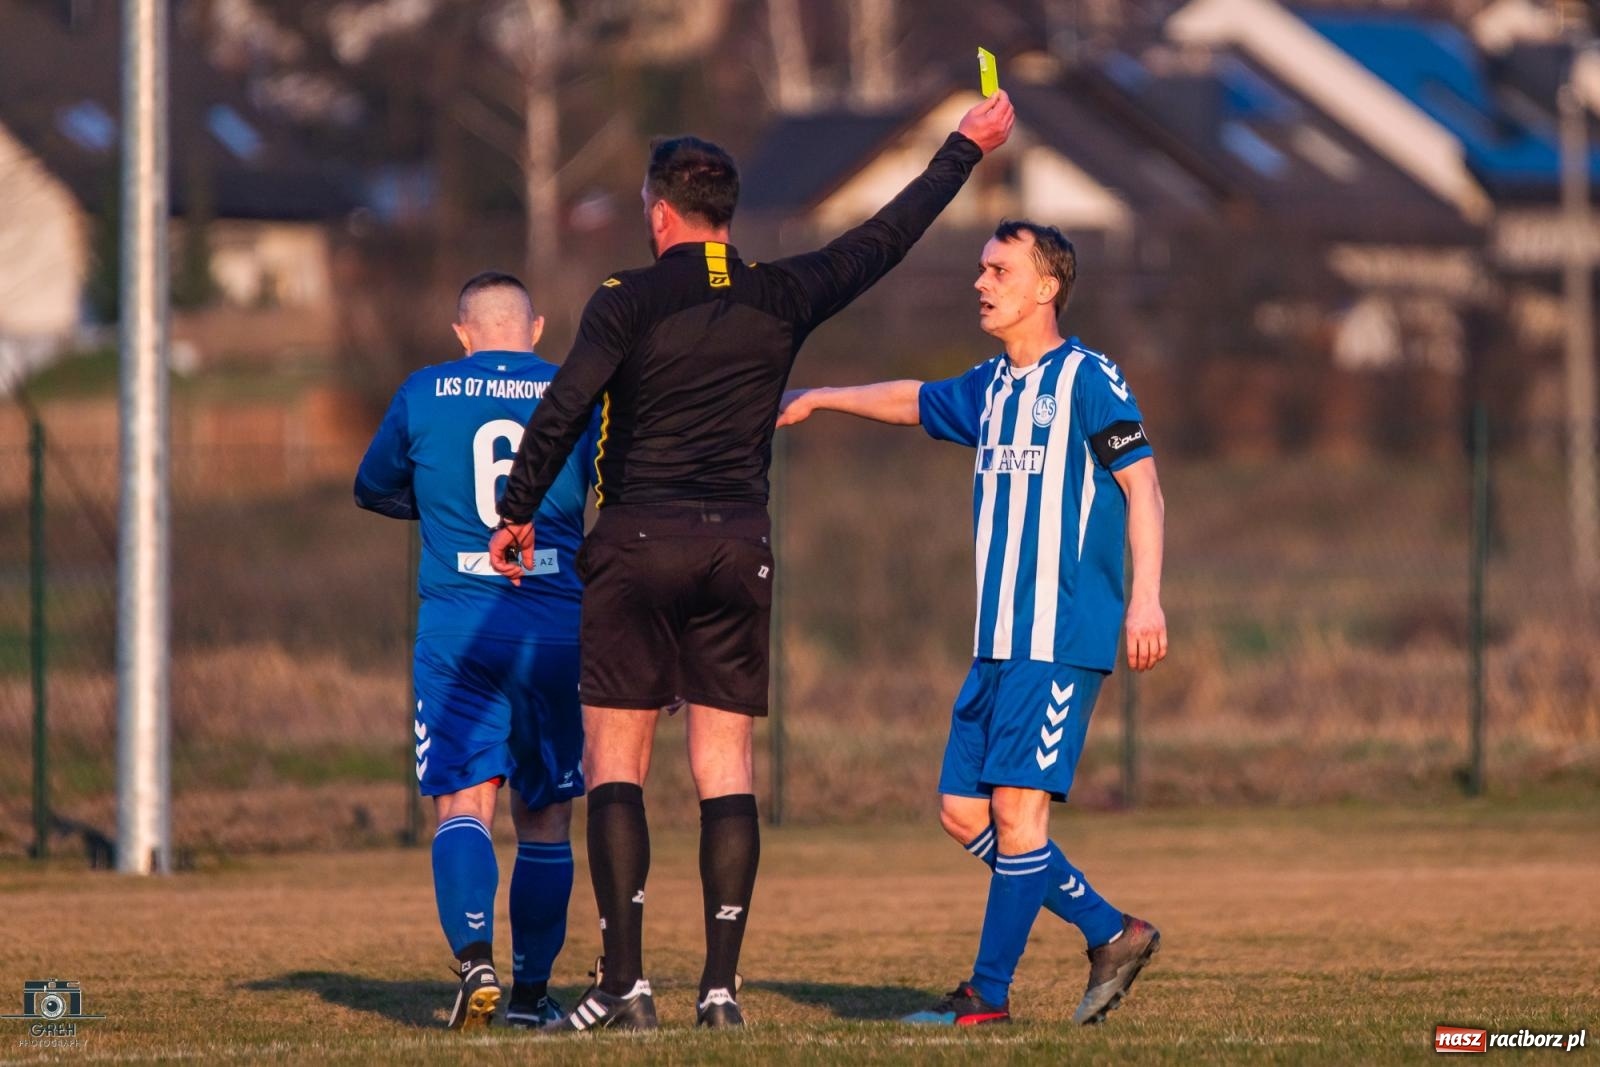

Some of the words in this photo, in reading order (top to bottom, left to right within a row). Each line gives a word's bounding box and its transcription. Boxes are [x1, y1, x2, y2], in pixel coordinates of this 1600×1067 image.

[435, 377, 462, 397] LKS
[465, 378, 482, 397] 07
[486, 379, 551, 399] MARKOW
[998, 448, 1041, 471] AMT
[472, 418, 526, 530] 6
[540, 557, 553, 566] AZ
